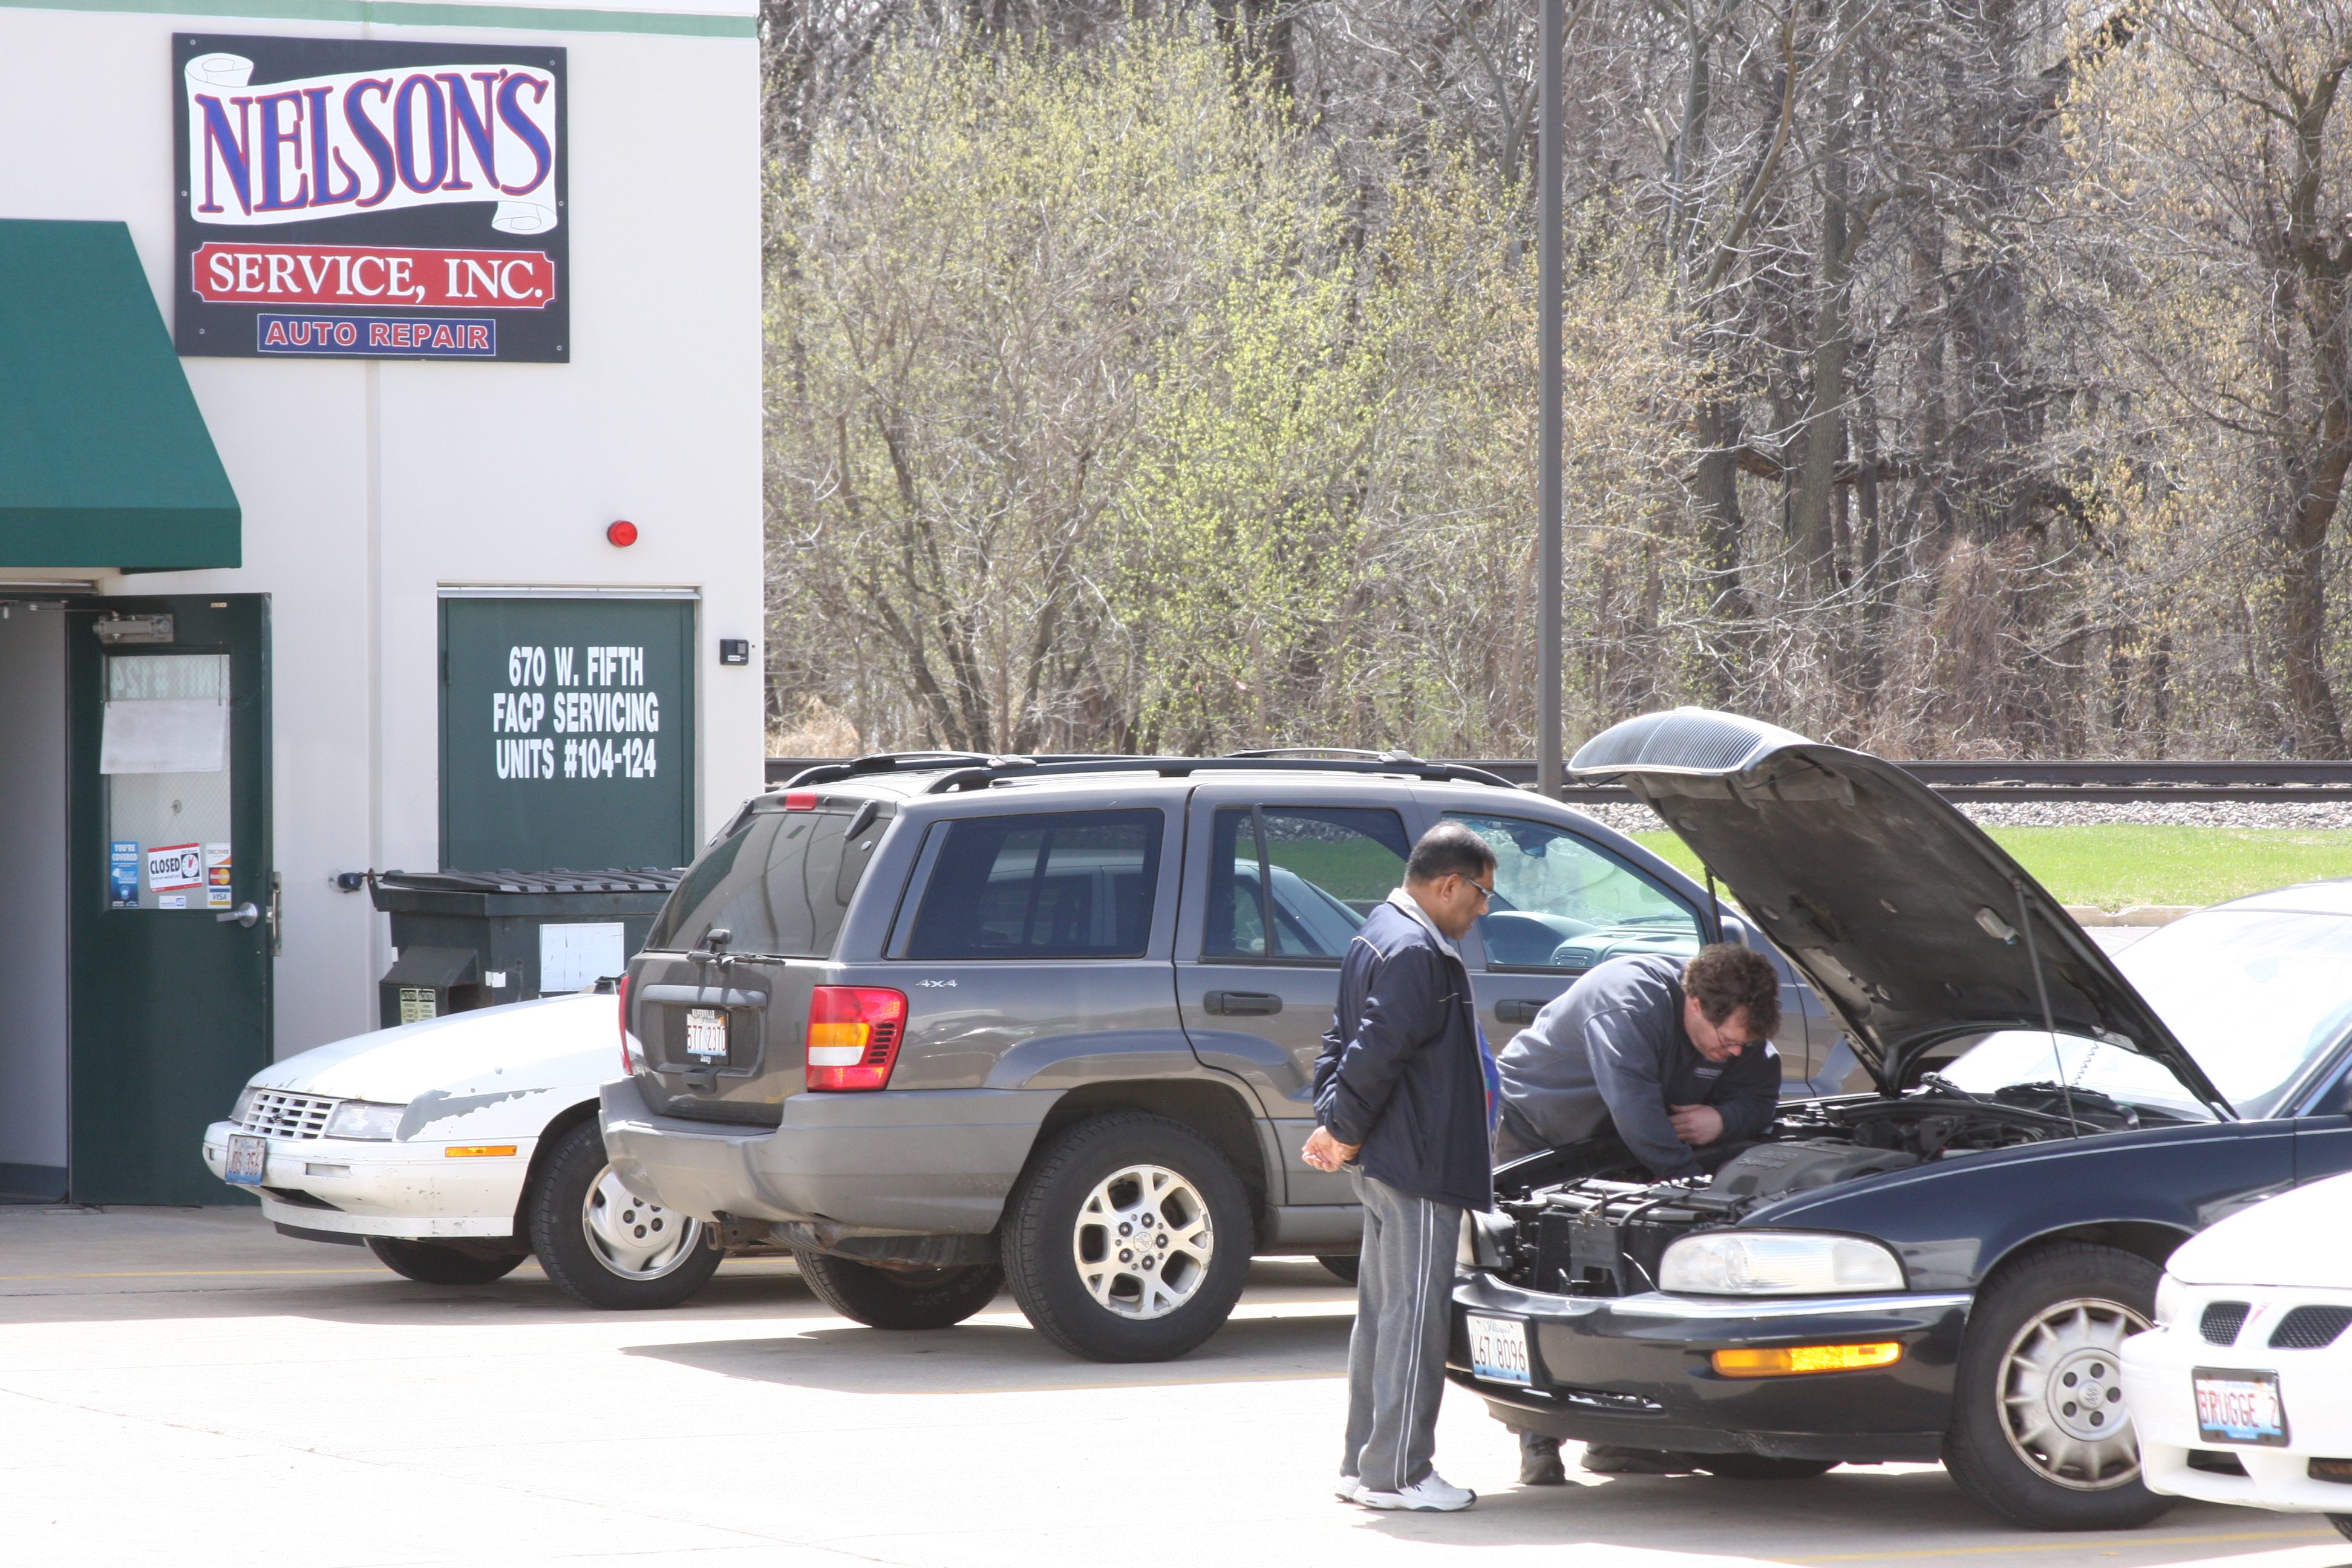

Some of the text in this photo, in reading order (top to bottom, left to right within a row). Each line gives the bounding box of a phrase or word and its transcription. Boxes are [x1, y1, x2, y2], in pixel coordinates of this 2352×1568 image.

[194, 68, 552, 216] NELSON'S
[209, 251, 543, 303] SERVICE, INC.
[265, 321, 489, 349] AUTO REPAIR
[509, 645, 644, 687] 670 W. FIFTH
[493, 691, 659, 733] FACP SERVICING
[496, 738, 656, 779] UNITS #104-124
[112, 853, 138, 861] COVERED
[150, 857, 180, 875] CLOSED
[691, 1008, 715, 1019] NAPERVILLE
[687, 1025, 726, 1051] 577 2370
[701, 1054, 711, 1065] Jeep
[1471, 1333, 1526, 1372] L67 8096
[2197, 1390, 2260, 1428] BRUGGE
